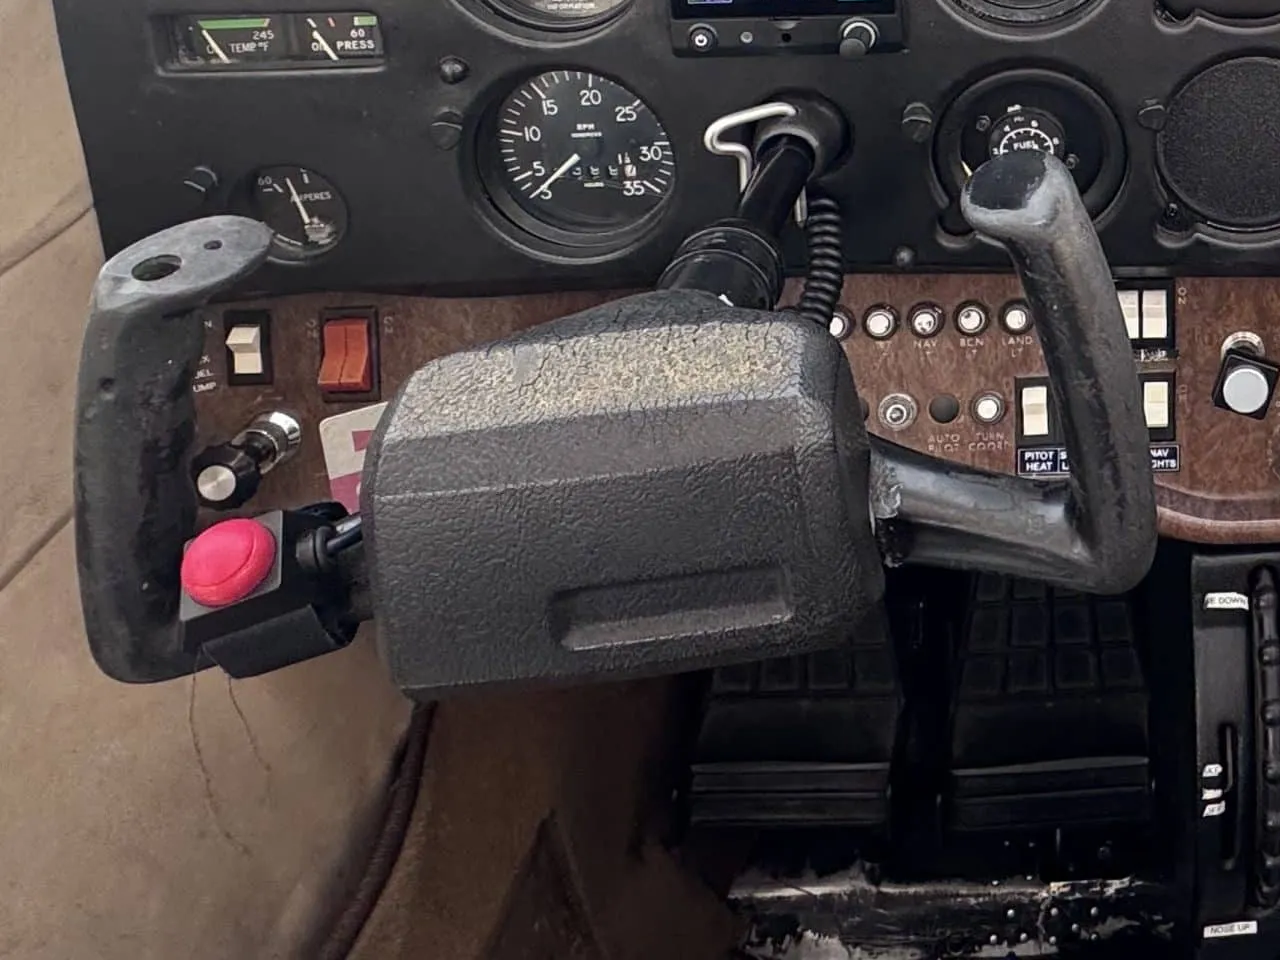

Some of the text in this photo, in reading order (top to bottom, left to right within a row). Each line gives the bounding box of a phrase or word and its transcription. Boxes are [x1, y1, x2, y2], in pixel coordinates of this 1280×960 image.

[252, 30, 274, 40] 245
[350, 28, 365, 38] 60
[336, 40, 375, 51] PRESS
[580, 90, 602, 106] 20
[542, 100, 558, 116] 15
[615, 106, 637, 122] 25
[524, 126, 541, 141] 10
[639, 146, 662, 161] 30
[532, 161, 545, 177] 5
[623, 180, 645, 196] 35
[1002, 336, 1033, 345] LAND
[929, 433, 960, 443] AUTO
[1025, 451, 1053, 461] PITOT
[1026, 462, 1053, 471] HEAT
